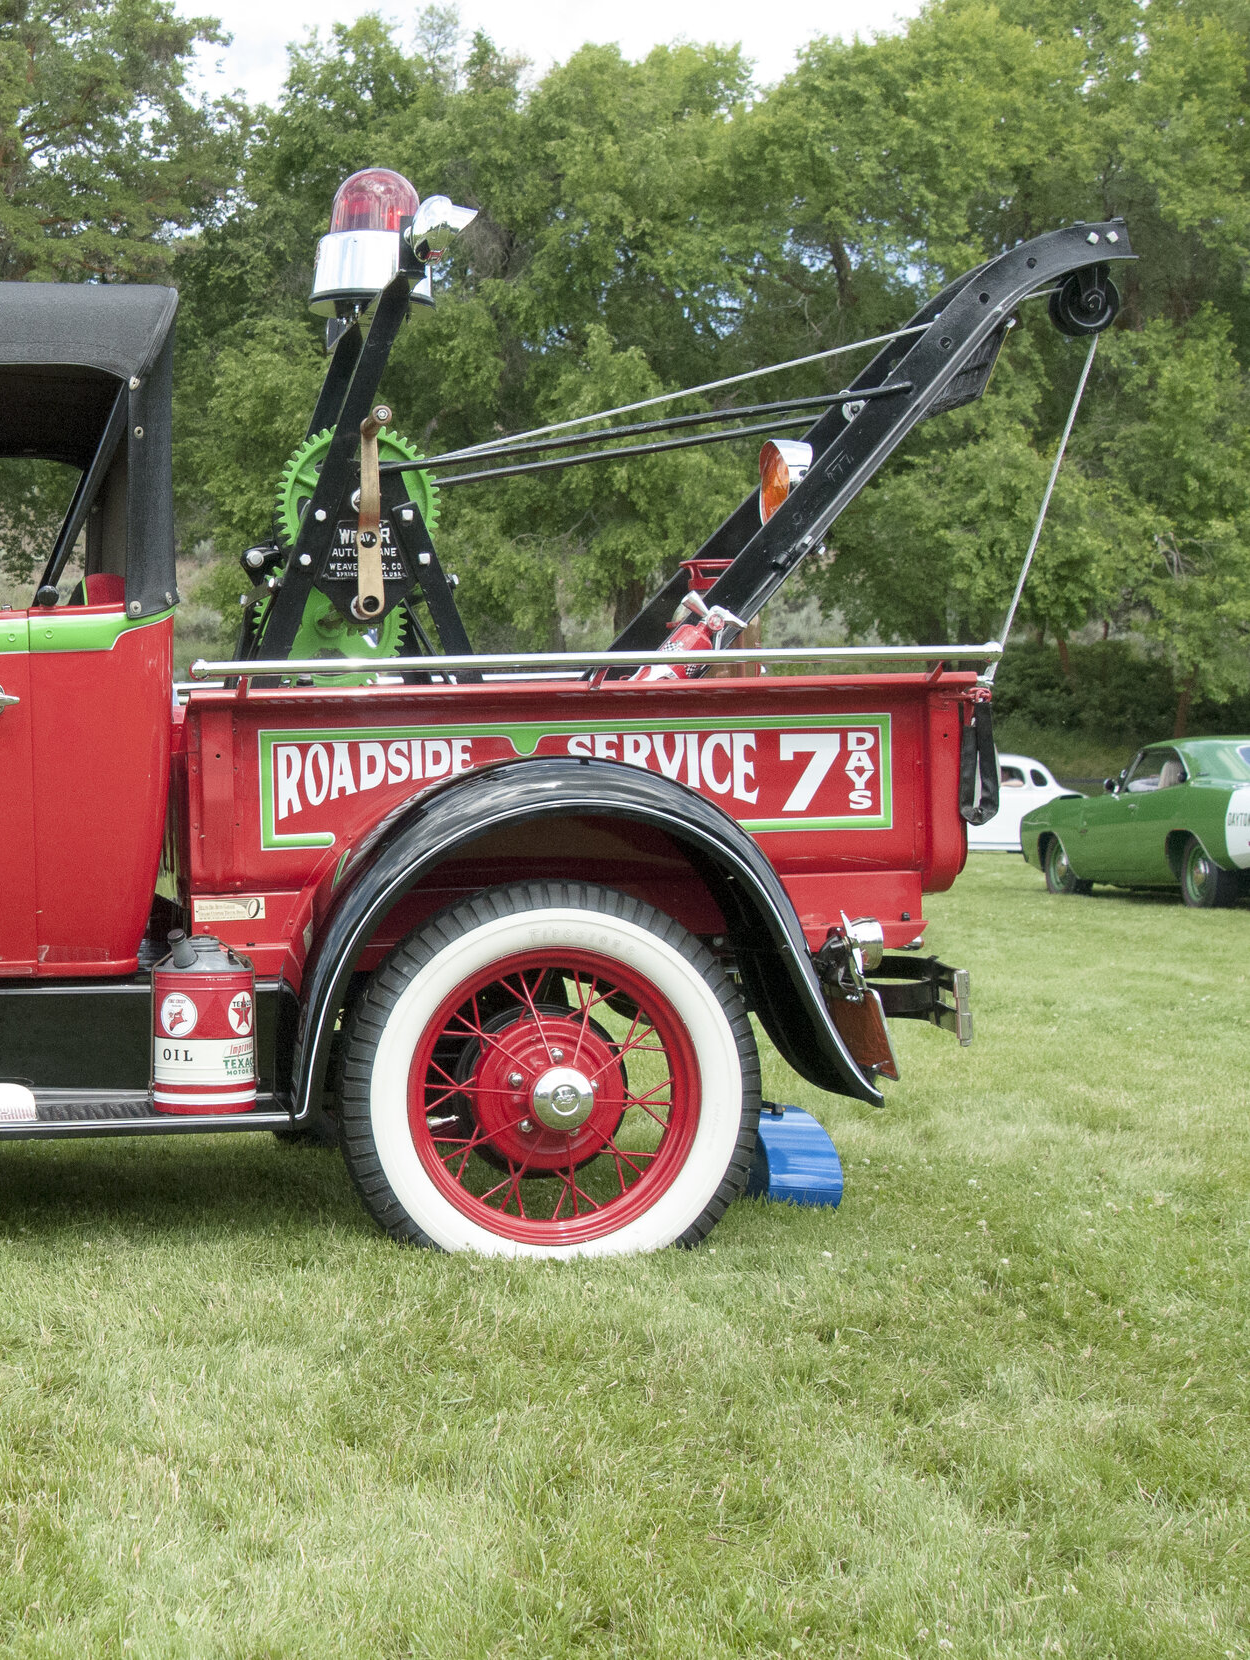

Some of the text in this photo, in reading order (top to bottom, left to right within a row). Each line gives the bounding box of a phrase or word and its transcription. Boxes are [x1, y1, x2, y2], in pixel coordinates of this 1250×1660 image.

[276, 737, 475, 821] ROADSIDE
[778, 733, 840, 812] 7
[846, 730, 875, 810] DAYS
[163, 1048, 193, 1062] OIL
